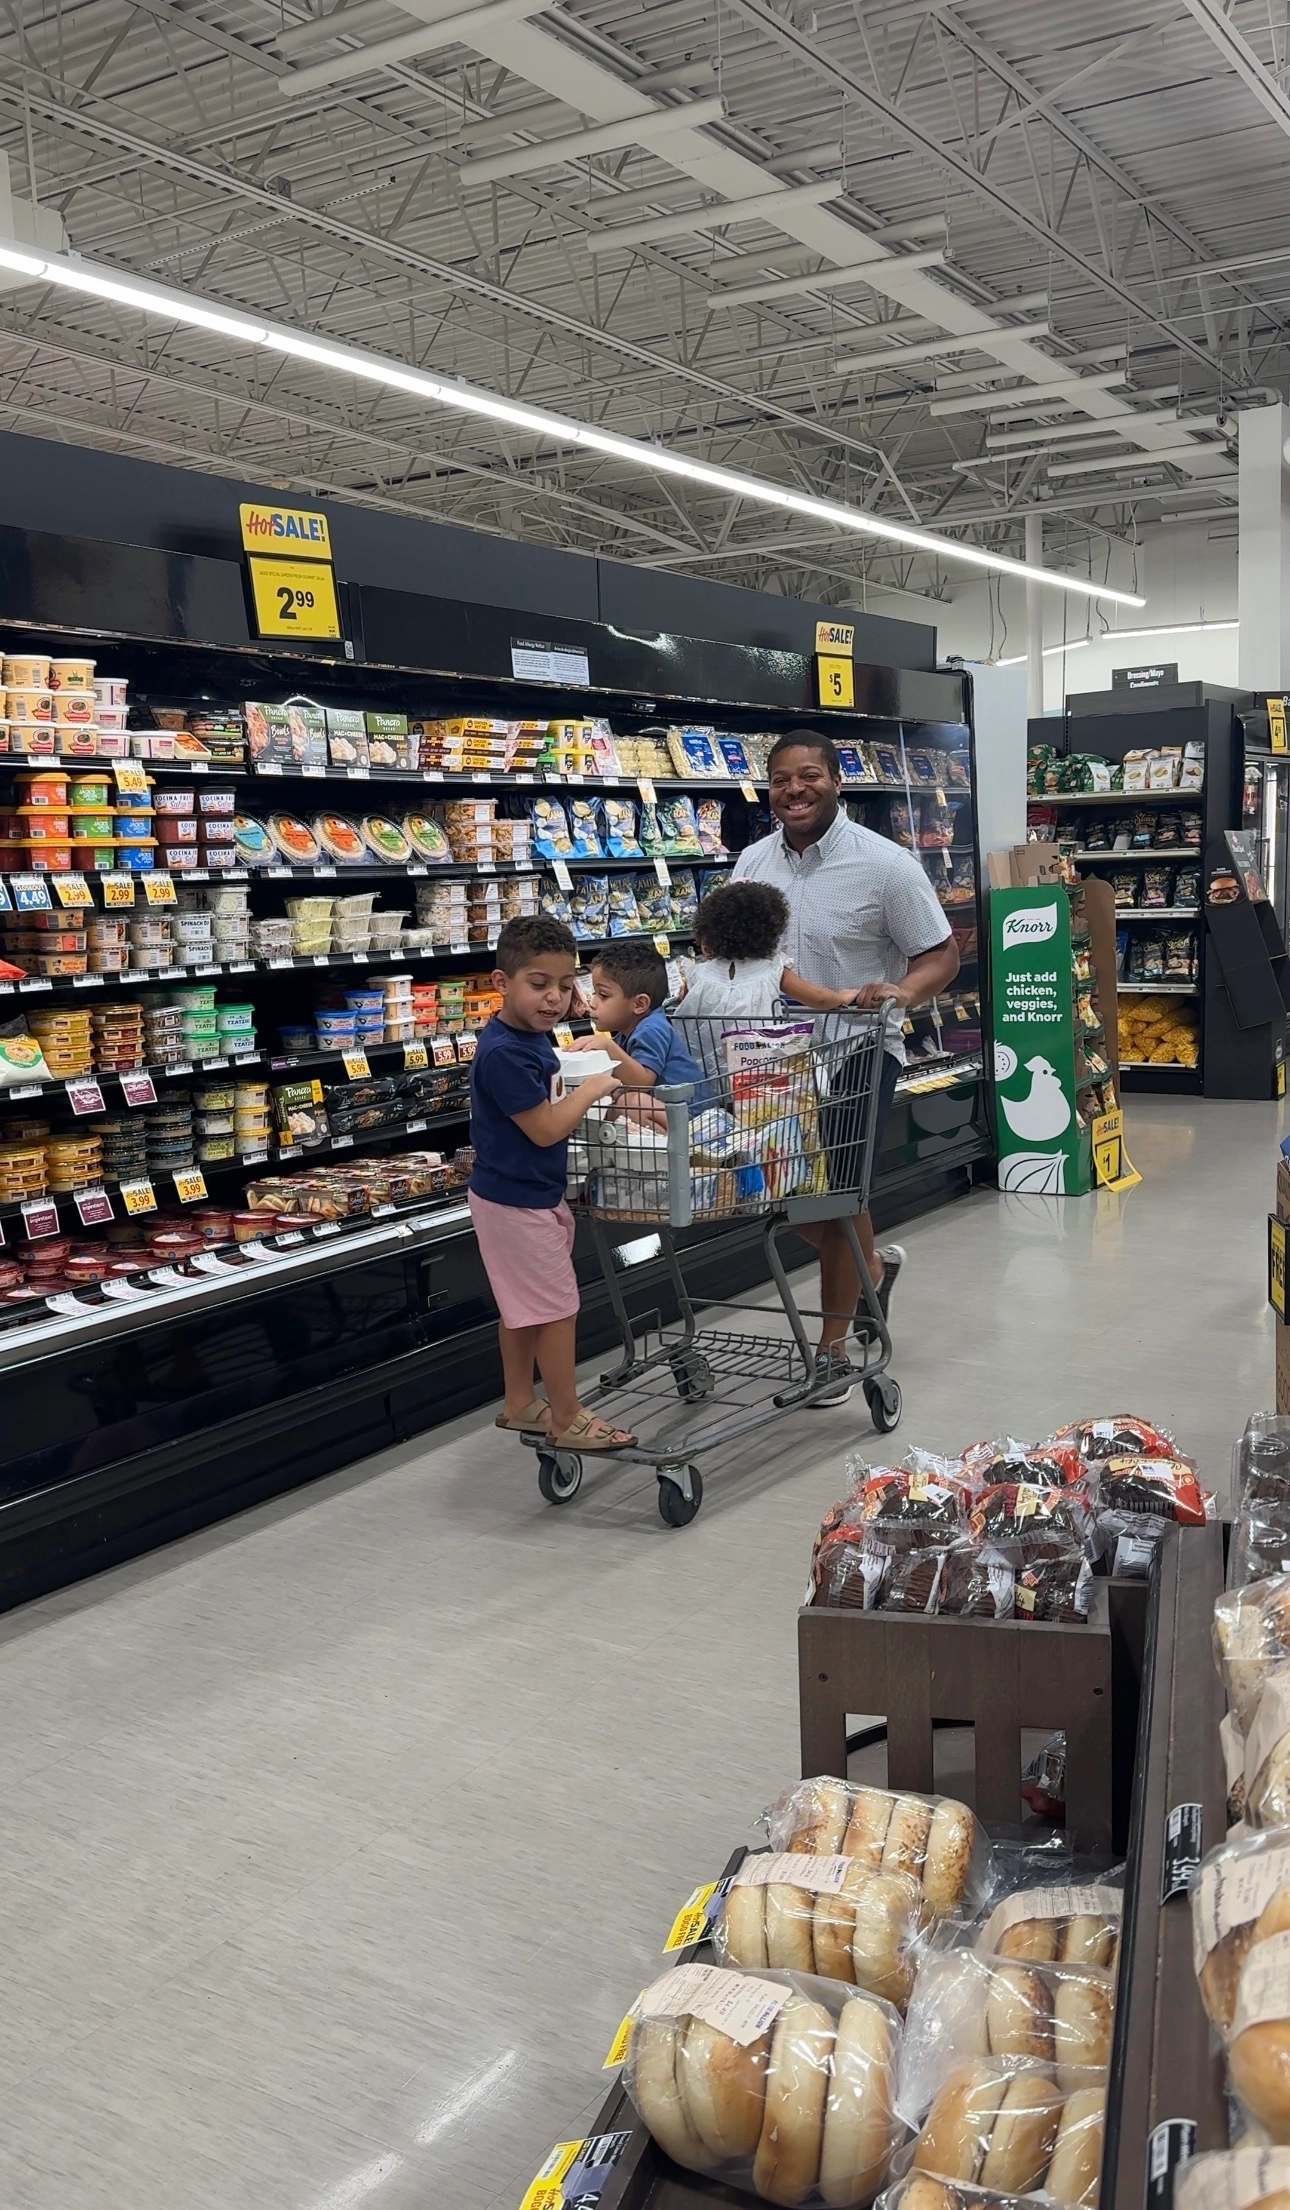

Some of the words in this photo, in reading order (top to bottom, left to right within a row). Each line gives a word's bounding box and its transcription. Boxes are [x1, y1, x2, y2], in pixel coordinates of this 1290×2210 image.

[264, 705, 288, 717] Panera
[335, 711, 360, 723] Panera
[375, 716, 401, 727] Panera
[270, 724, 291, 738] Bowls
[20, 891, 46, 905] 4.49
[65, 890, 86, 900] 2.99
[111, 889, 130, 900] 2.99
[152, 888, 171, 898] 2.99
[1006, 919, 1053, 933] Knorr
[1005, 972, 1032, 982] Just
[1034, 972, 1057, 982] add
[1006, 984, 1057, 997] chicken,
[1006, 997, 1057, 1011] veggies,
[1002, 1012, 1026, 1022] and
[1028, 1012, 1063, 1022] Knorr
[462, 1046, 475, 1056] 5.99
[734, 1042, 755, 1051] FOOD
[409, 1055, 424, 1064] 5.99
[438, 1051, 452, 1060] 5.99
[741, 1057, 778, 1066] Popco
[350, 1064, 366, 1073] 5.99
[285, 1086, 312, 1098] Panera
[1096, 1117, 1119, 1136] SALE!
[183, 1184, 201, 1196] 3.99
[130, 1195, 150, 1208] 3.99
[679, 1914, 693, 1932] BOGO
[672, 1931, 686, 1948] FREE
